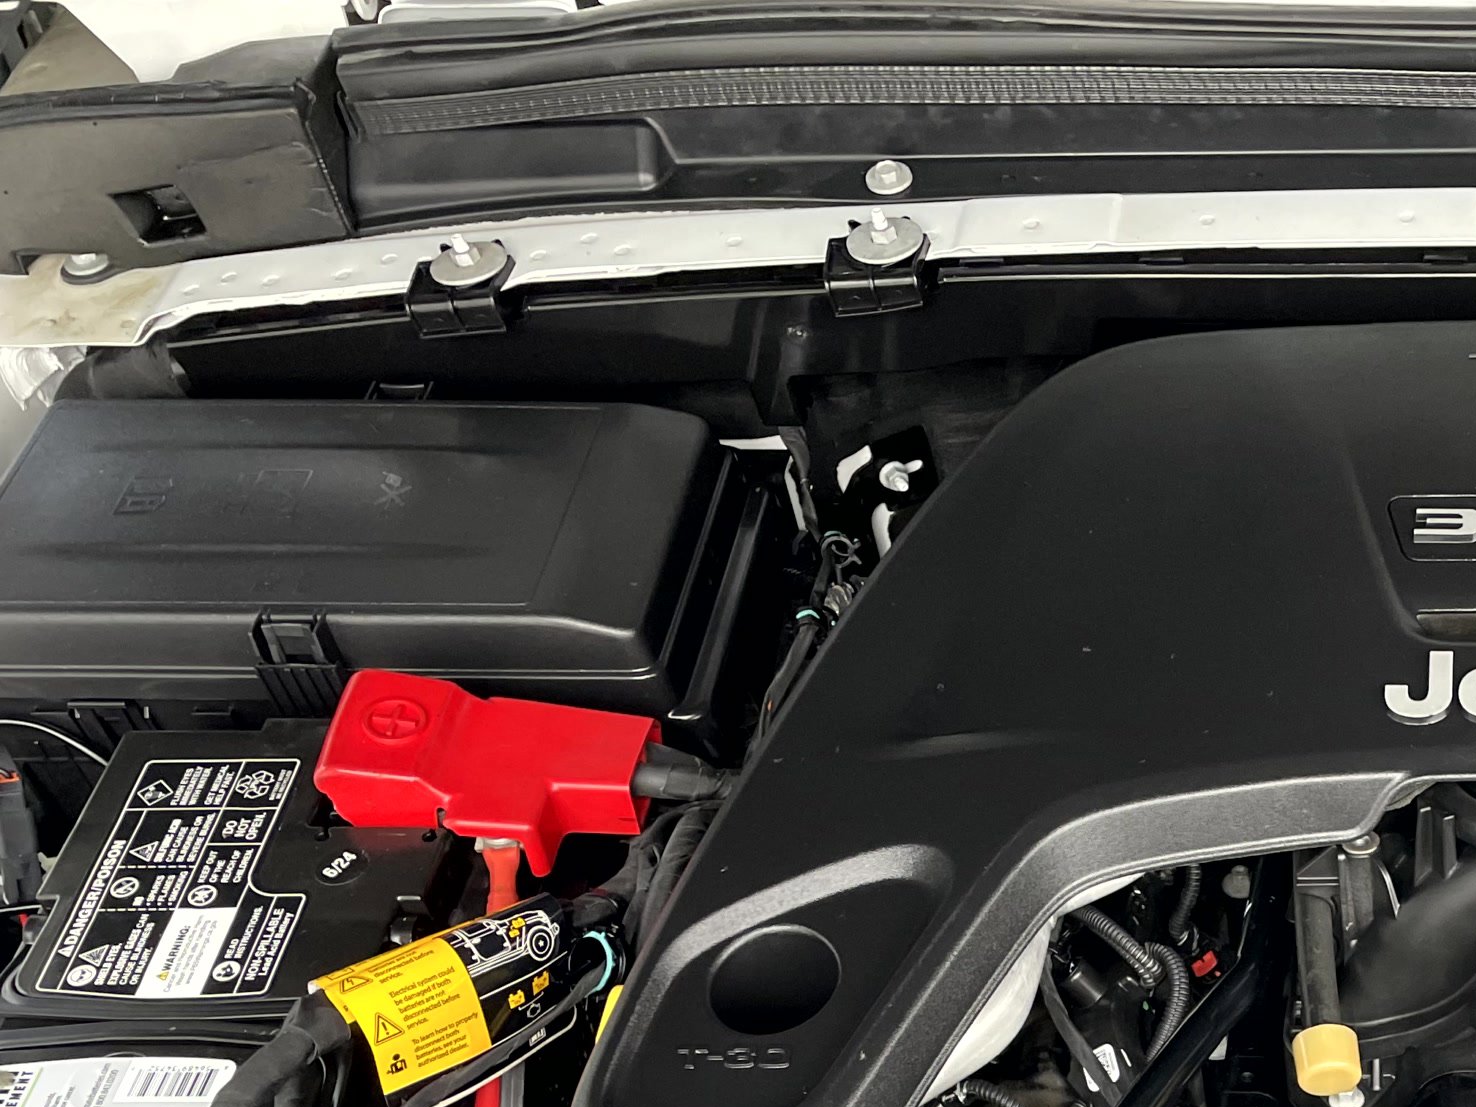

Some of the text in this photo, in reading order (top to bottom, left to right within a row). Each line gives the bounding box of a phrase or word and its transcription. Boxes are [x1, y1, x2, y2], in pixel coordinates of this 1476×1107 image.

[221, 820, 237, 834] DO
[233, 817, 252, 836] NOT
[244, 812, 267, 839] OPEN.
[196, 850, 218, 883] KEEP OUT
[220, 860, 237, 883] REACH
[322, 851, 357, 878] 6/24
[67, 839, 127, 947] DANGER/POISON
[233, 905, 263, 958] INSTRUCTIONS.
[244, 908, 284, 980] NON-SPILLABLE
[160, 925, 191, 971] WARNING:
[223, 938, 239, 958] READ
[119, 962, 138, 984] CAUSE
[388, 965, 455, 998] Electrical system could
[393, 997, 404, 1006] be
[403, 985, 432, 1002] damaged
[436, 977, 451, 988] both
[398, 989, 446, 1014] batteries are not
[402, 992, 460, 1022] disconnected before
[411, 1037, 420, 1045] To
[419, 1030, 435, 1042] learn
[445, 1028, 459, 1038] both
[675, 1047, 790, 1069] T-30
